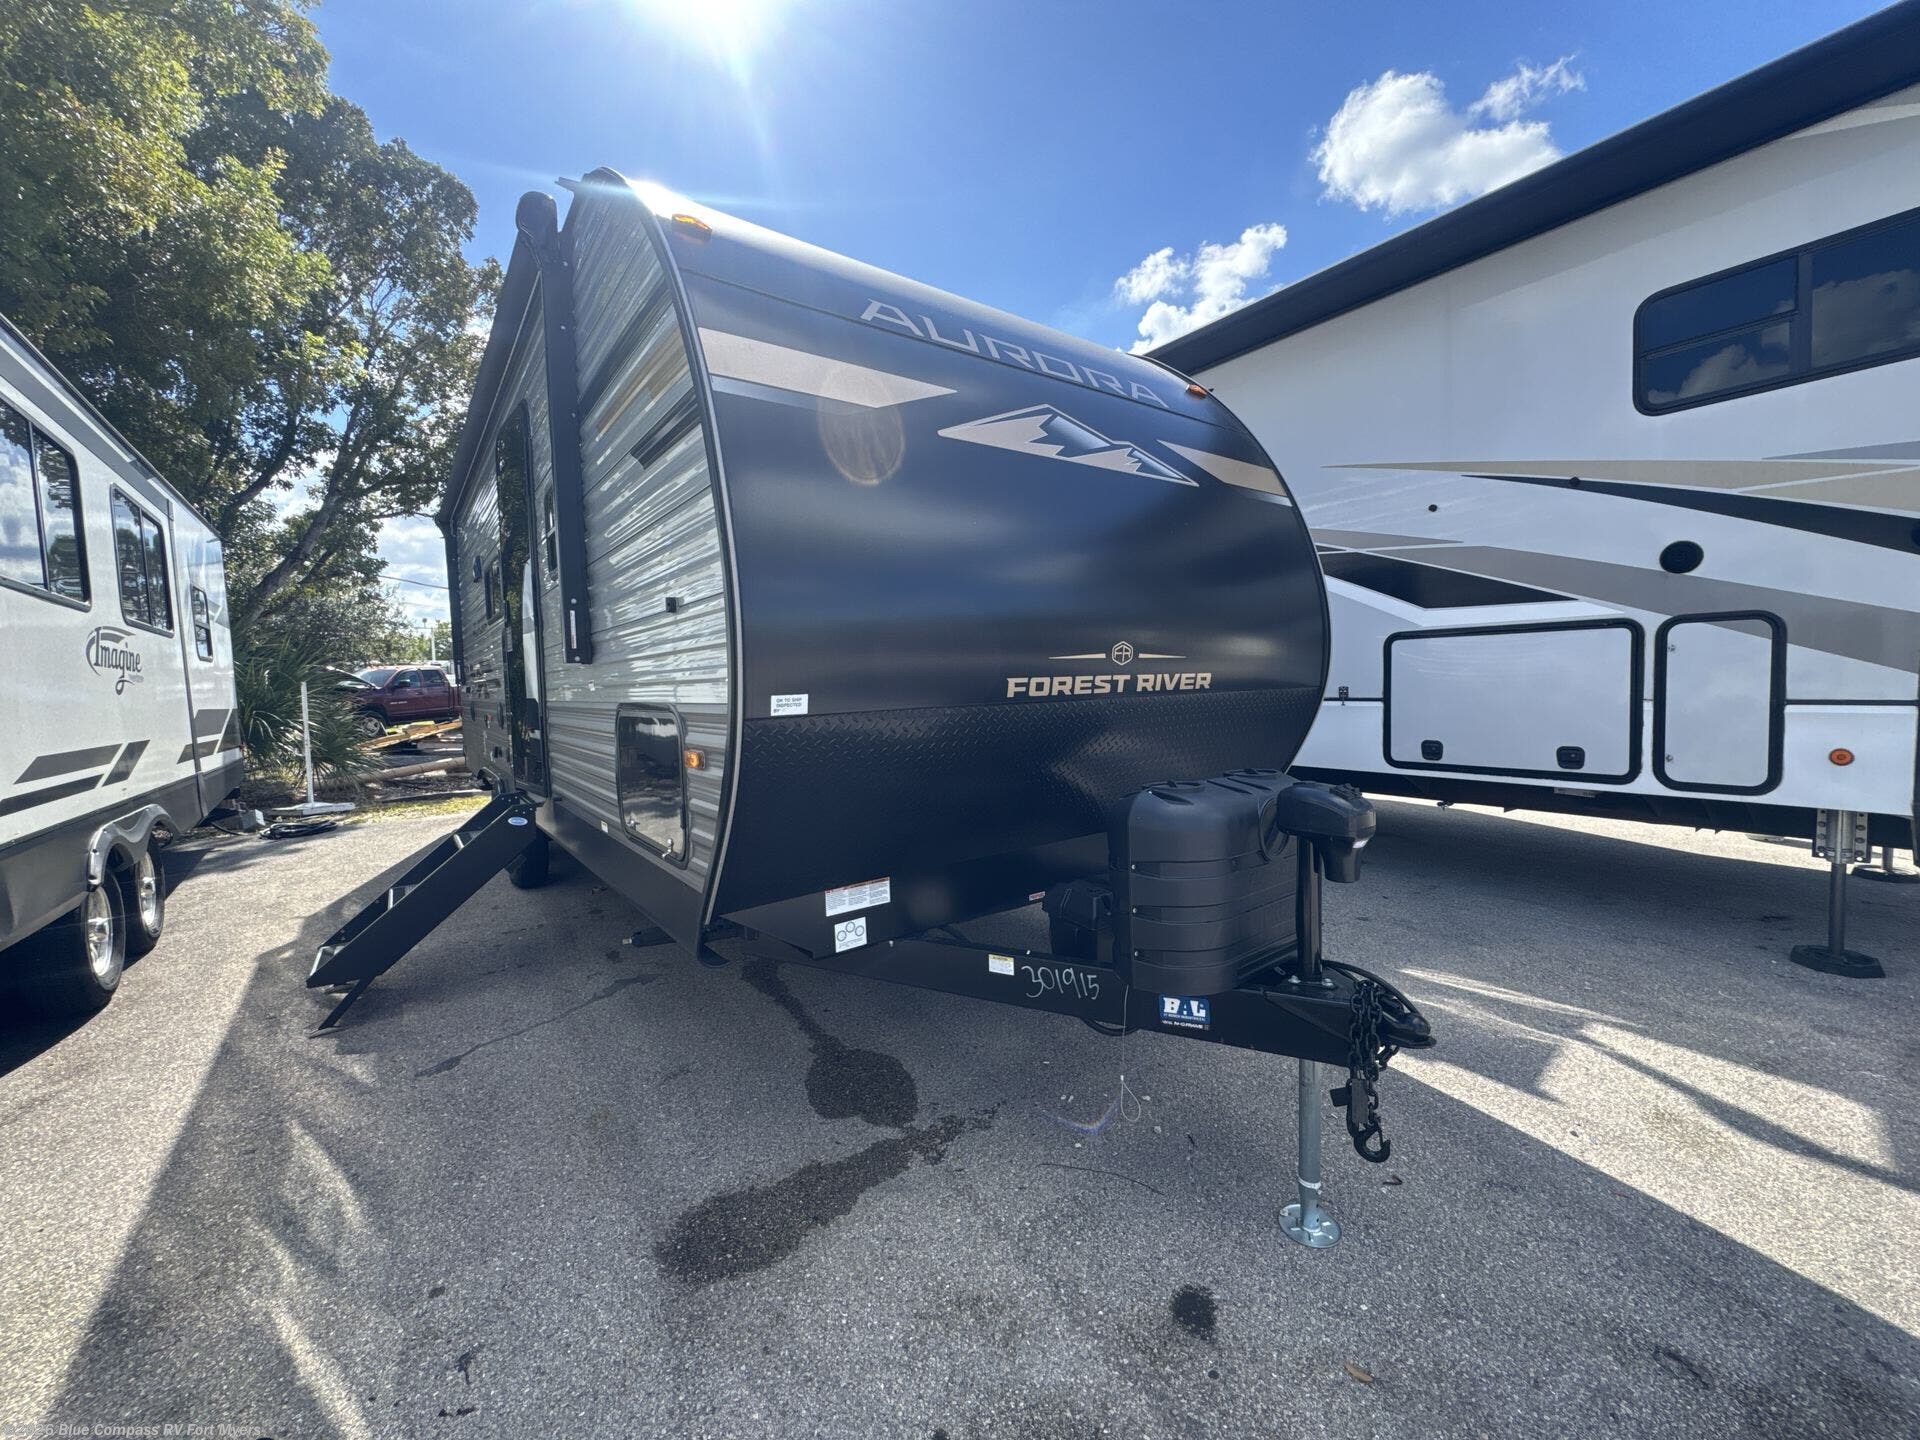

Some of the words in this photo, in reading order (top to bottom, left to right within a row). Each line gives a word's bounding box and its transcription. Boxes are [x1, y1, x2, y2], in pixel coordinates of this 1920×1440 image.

[860, 298, 1170, 409] AURORA
[93, 626, 143, 696] Imagine
[1006, 674, 1131, 698] FOREST
[1136, 672, 1212, 692] RIVER
[1021, 966, 1100, 1000] 301915
[1163, 997, 1206, 1018] BAL
